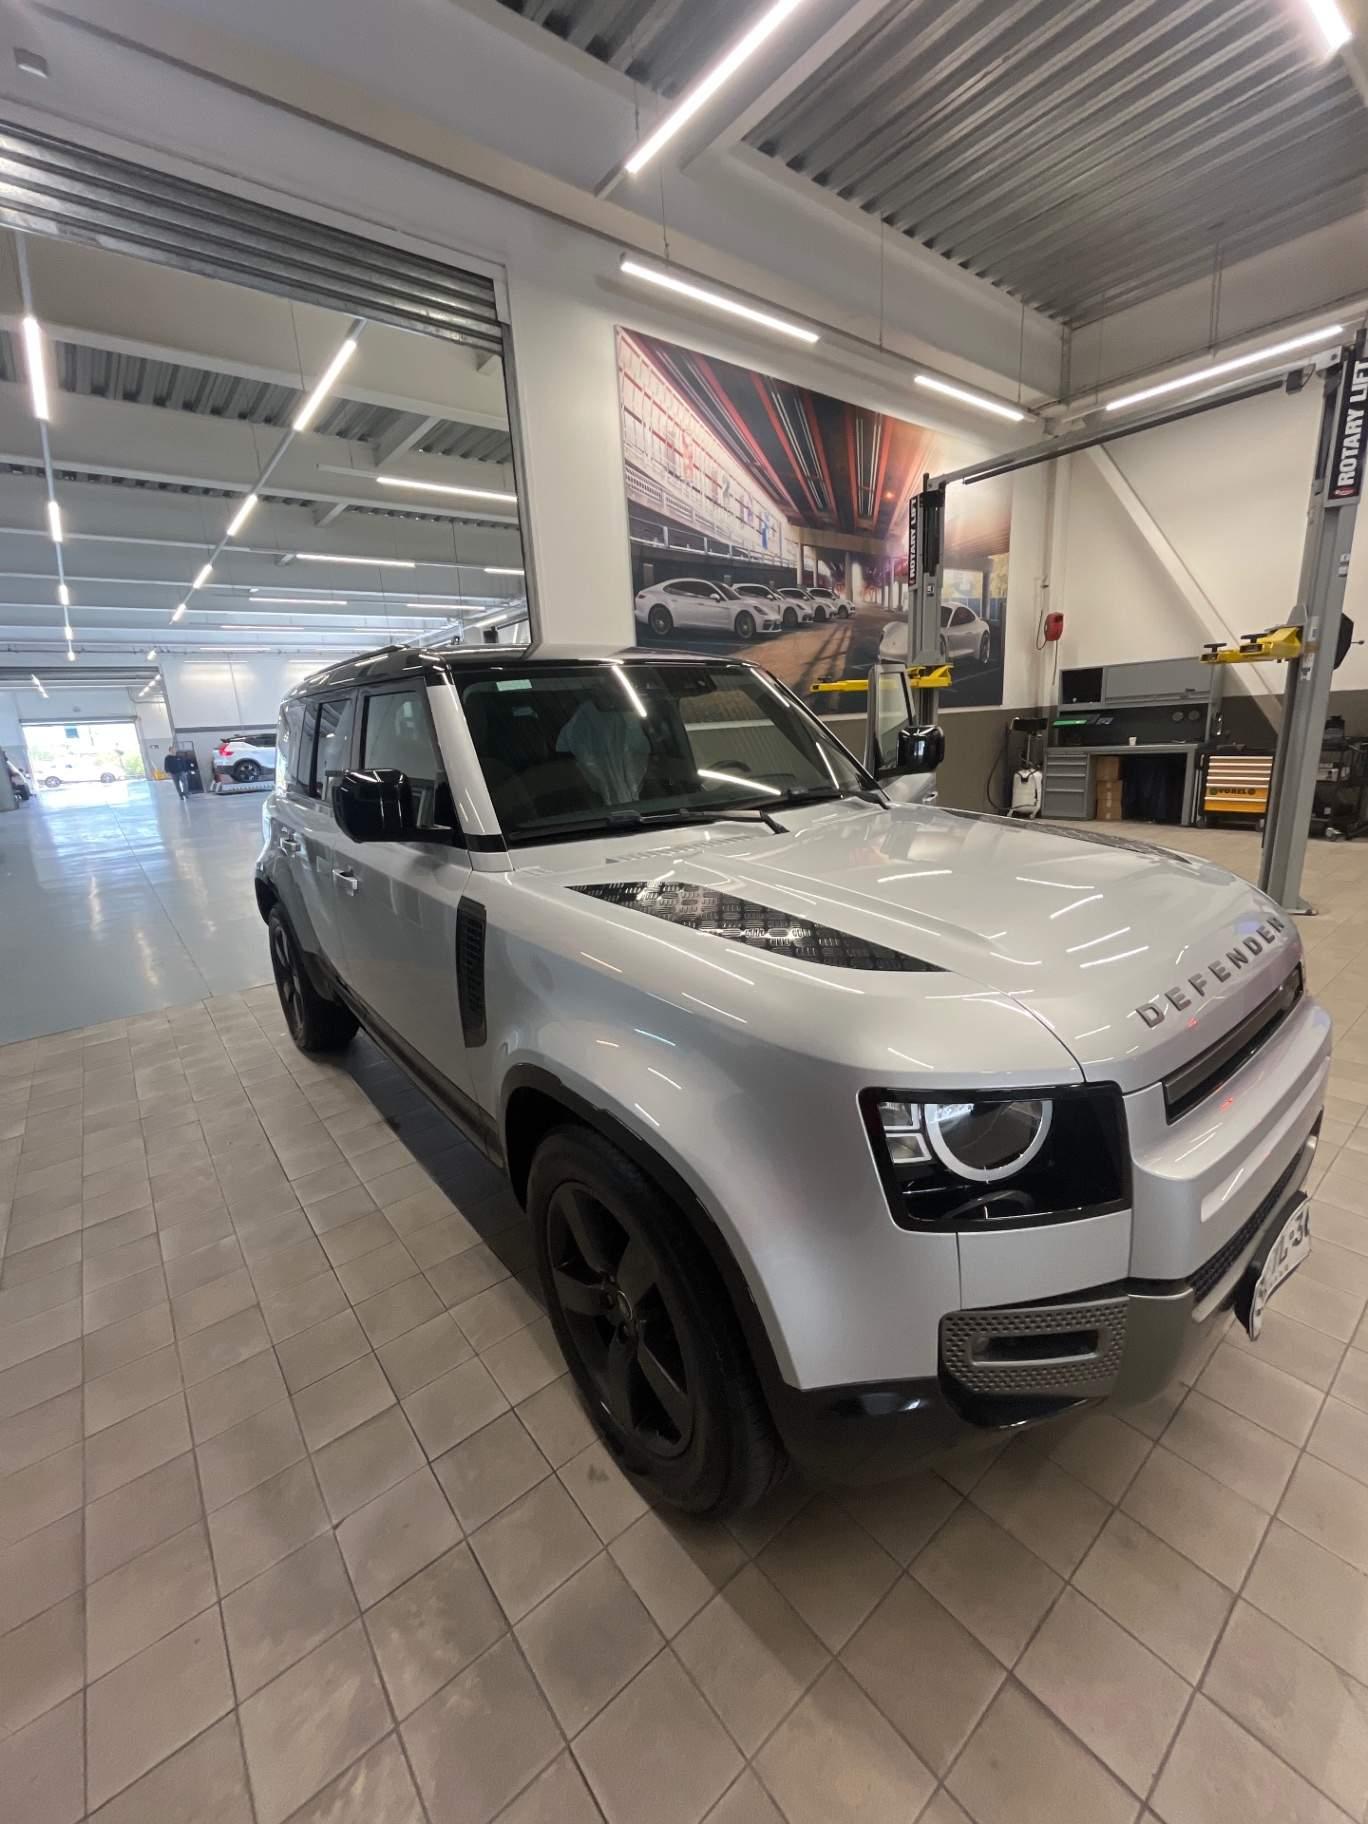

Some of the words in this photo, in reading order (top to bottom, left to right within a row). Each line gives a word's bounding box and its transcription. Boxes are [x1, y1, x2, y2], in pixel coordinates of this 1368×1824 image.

[1350, 360, 1368, 403] LIFT
[1337, 409, 1365, 487] ROTARY
[1135, 917, 1285, 1028] DEFENDER
